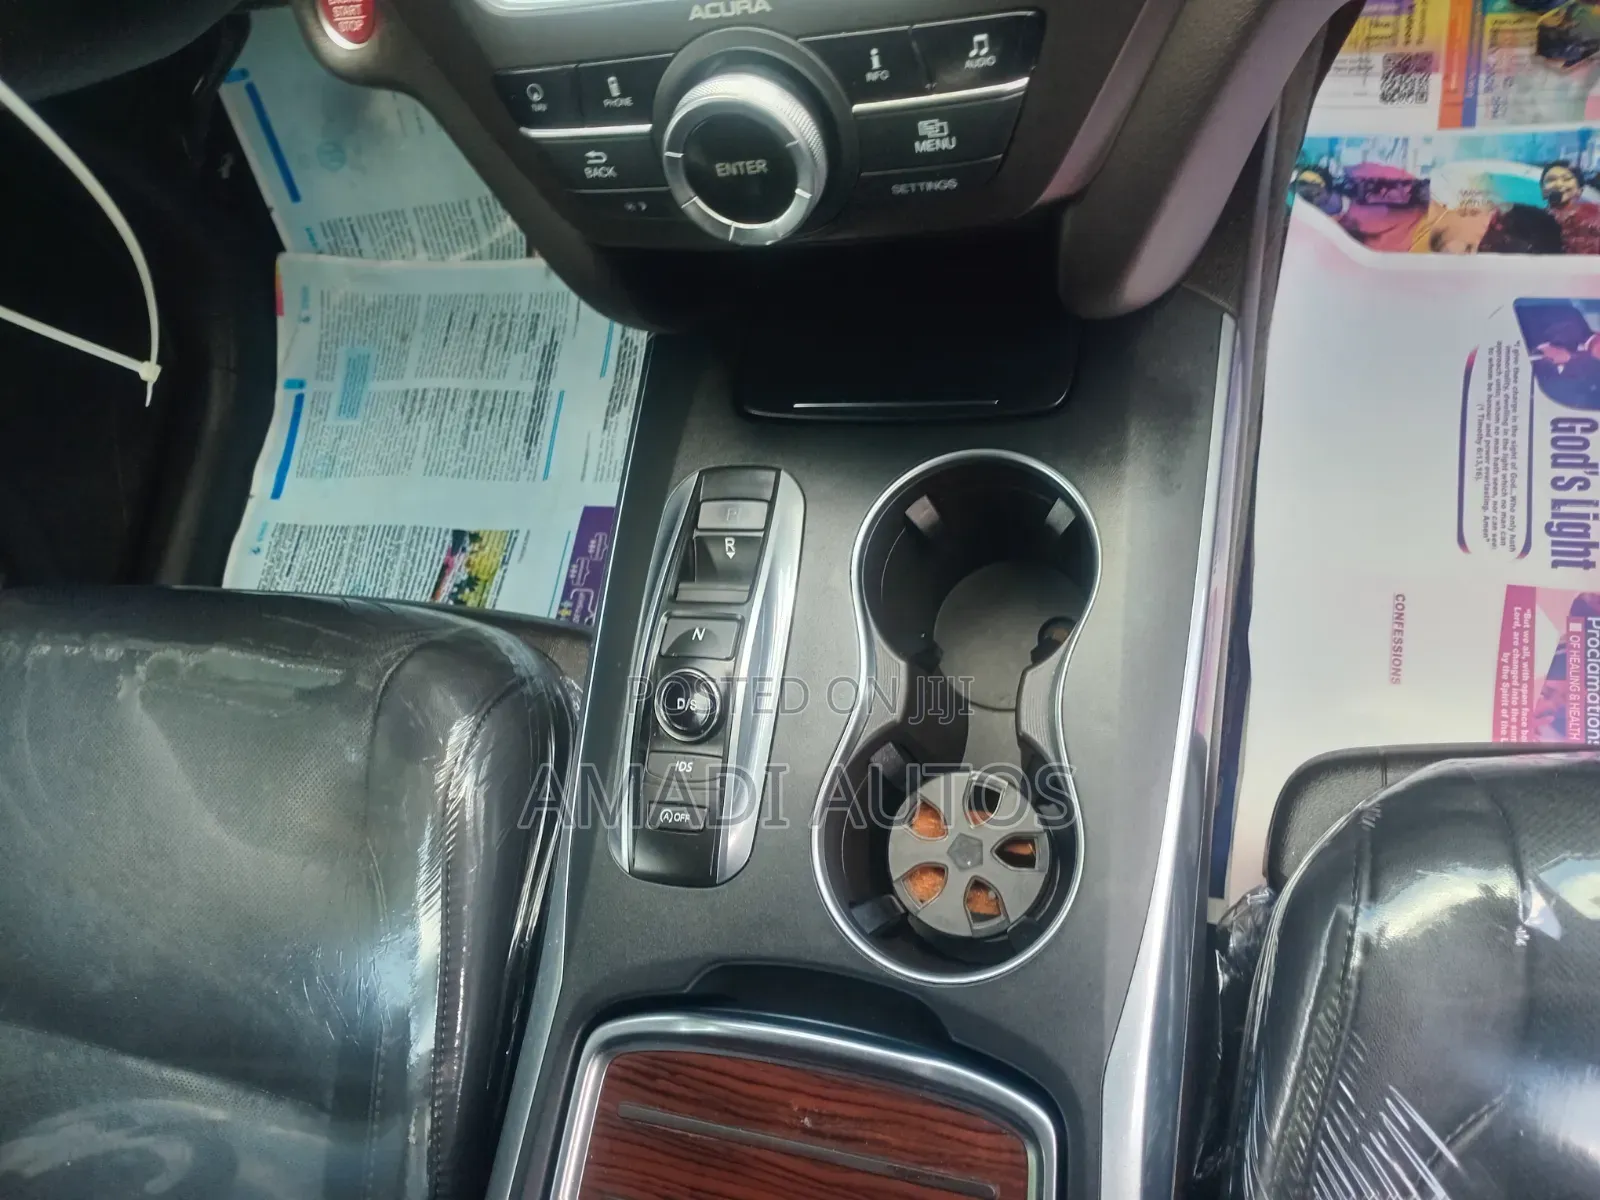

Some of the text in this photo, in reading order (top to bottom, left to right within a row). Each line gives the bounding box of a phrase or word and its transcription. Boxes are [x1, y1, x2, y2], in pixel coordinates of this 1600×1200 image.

[332, 4, 362, 17] START
[689, 0, 773, 20] ACURA
[338, 20, 364, 32] STOP
[964, 55, 997, 69] AUDIO
[865, 70, 890, 82] INFO
[603, 97, 633, 107] PHONE
[914, 136, 957, 153] MENU
[584, 166, 618, 178] BACK
[715, 159, 768, 177] ENTER
[891, 178, 958, 195] SETTINGS
[1511, 387, 1519, 412] charge
[1502, 394, 1510, 426] dwelling
[1475, 414, 1484, 444] Timothy
[1509, 440, 1517, 460] sight
[1500, 453, 1508, 471] light
[1545, 417, 1600, 570] God's Light
[1508, 515, 1516, 532] only
[725, 537, 736, 552] R
[692, 627, 706, 641] N
[1391, 594, 1405, 684] CONFESSIONS
[1523, 630, 1529, 644] we
[1569, 635, 1580, 648] OF
[1501, 652, 1510, 663] by
[1502, 666, 1510, 680] the
[1511, 648, 1520, 686] changed
[1522, 662, 1530, 680] with
[1569, 650, 1580, 692] HEALING
[1500, 682, 1510, 706] Spirit
[1511, 688, 1519, 705] into
[1520, 684, 1528, 705] open
[677, 698, 697, 711] D/S
[1502, 708, 1508, 718] of
[1569, 702, 1580, 740] HEALTH
[675, 761, 693, 773] IDS
[673, 813, 690, 822] OFF
